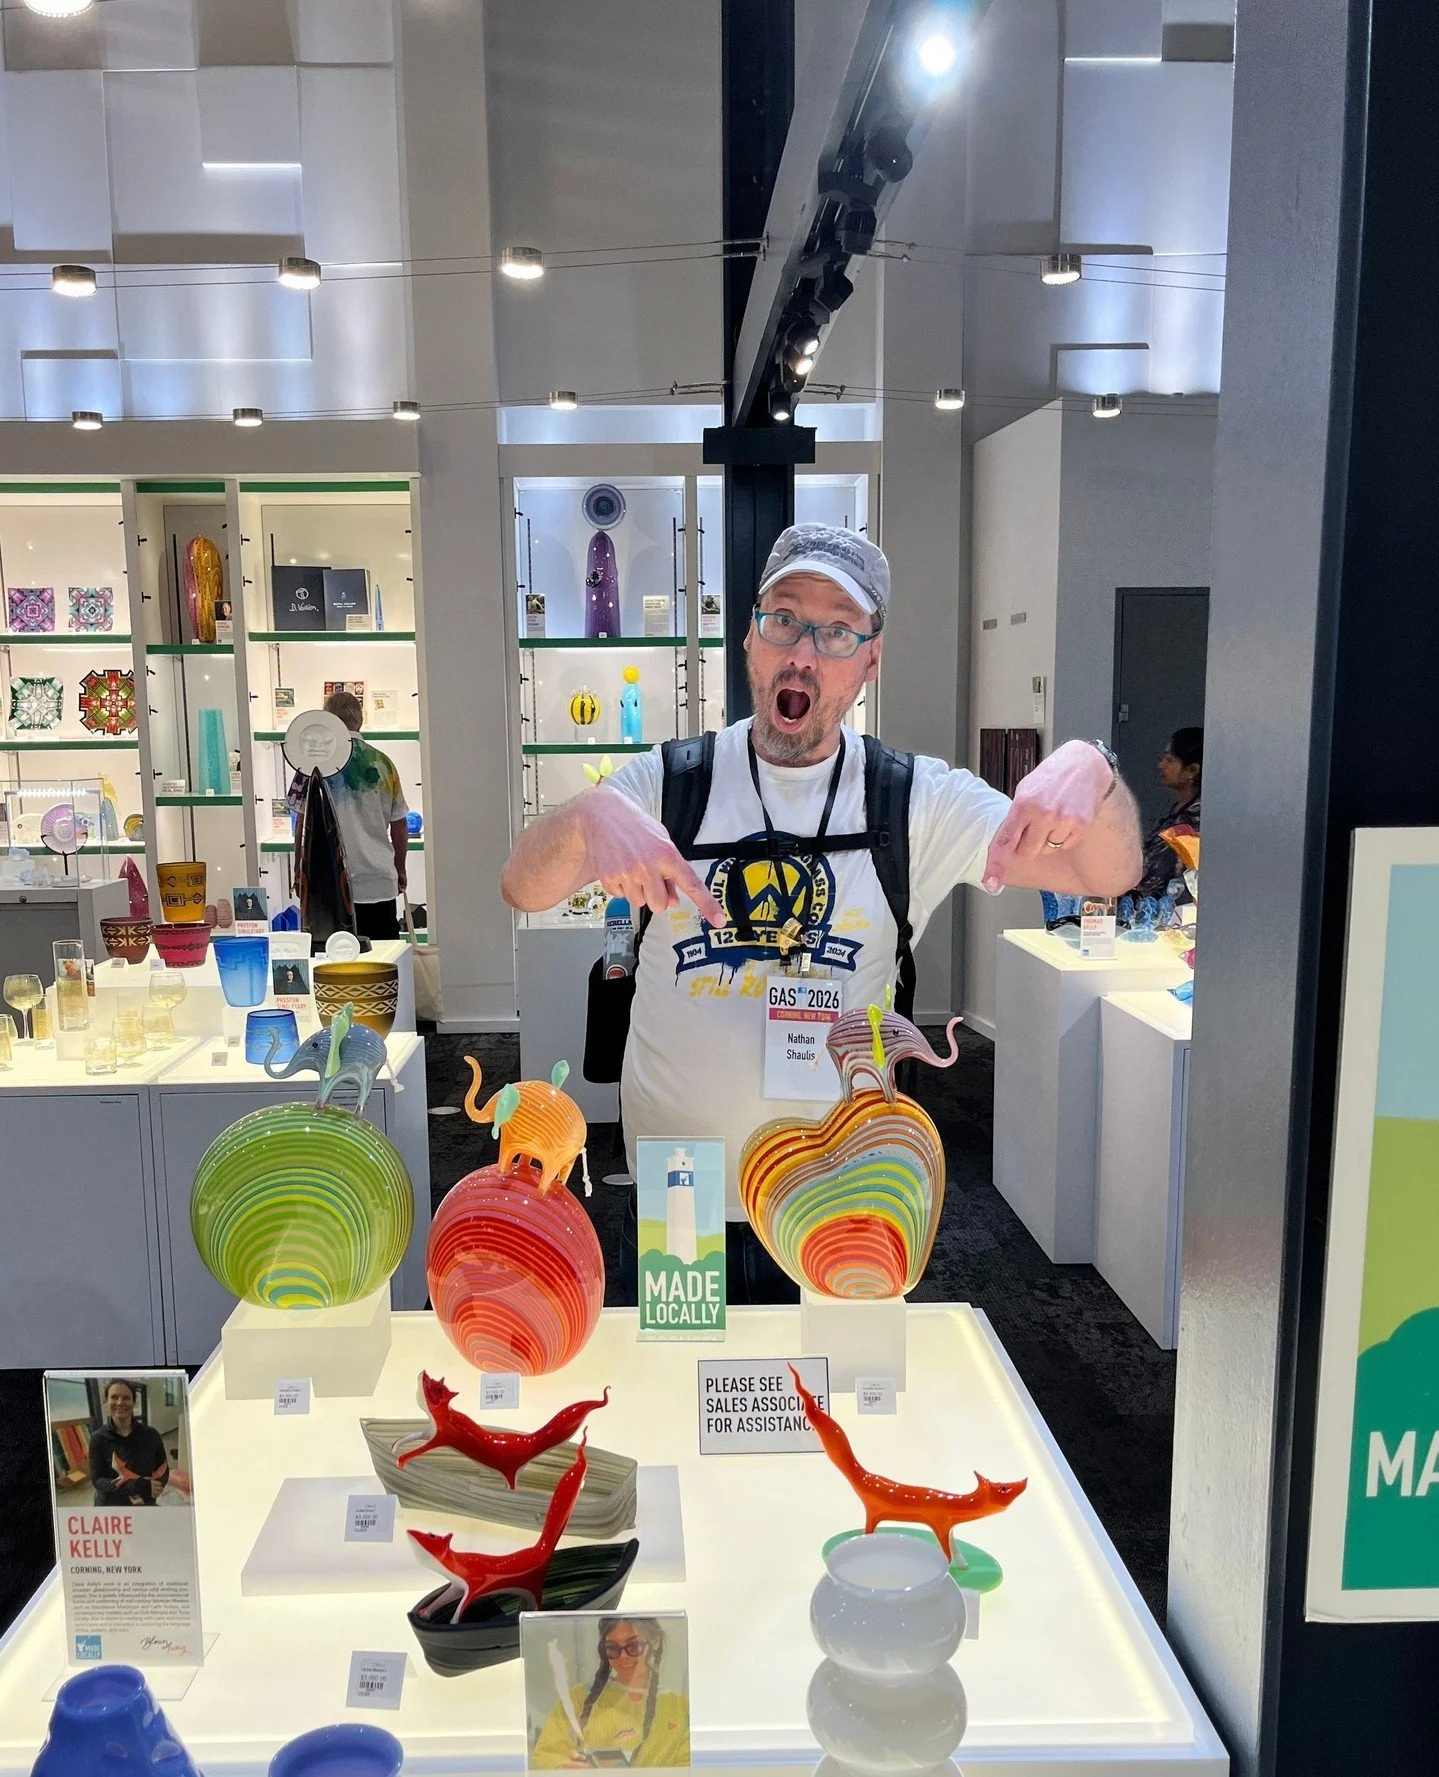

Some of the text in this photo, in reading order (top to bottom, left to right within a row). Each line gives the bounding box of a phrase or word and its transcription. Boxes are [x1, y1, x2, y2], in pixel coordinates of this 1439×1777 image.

[769, 986, 840, 1009] GAS 2026
[787, 1033, 815, 1044] Nathan
[786, 1049, 816, 1060] Shaulis
[645, 1270, 720, 1302] MADE
[645, 1303, 720, 1324] LOCALLY
[706, 1376, 783, 1393] PLEASE SEE
[706, 1395, 825, 1413] SALES ASSOCIE
[707, 1416, 815, 1433] FOR ASSISTANC
[67, 1515, 133, 1536] CLAIRE
[69, 1539, 123, 1559] KELLY
[70, 1565, 142, 1575] CORNING, NEW YORK
